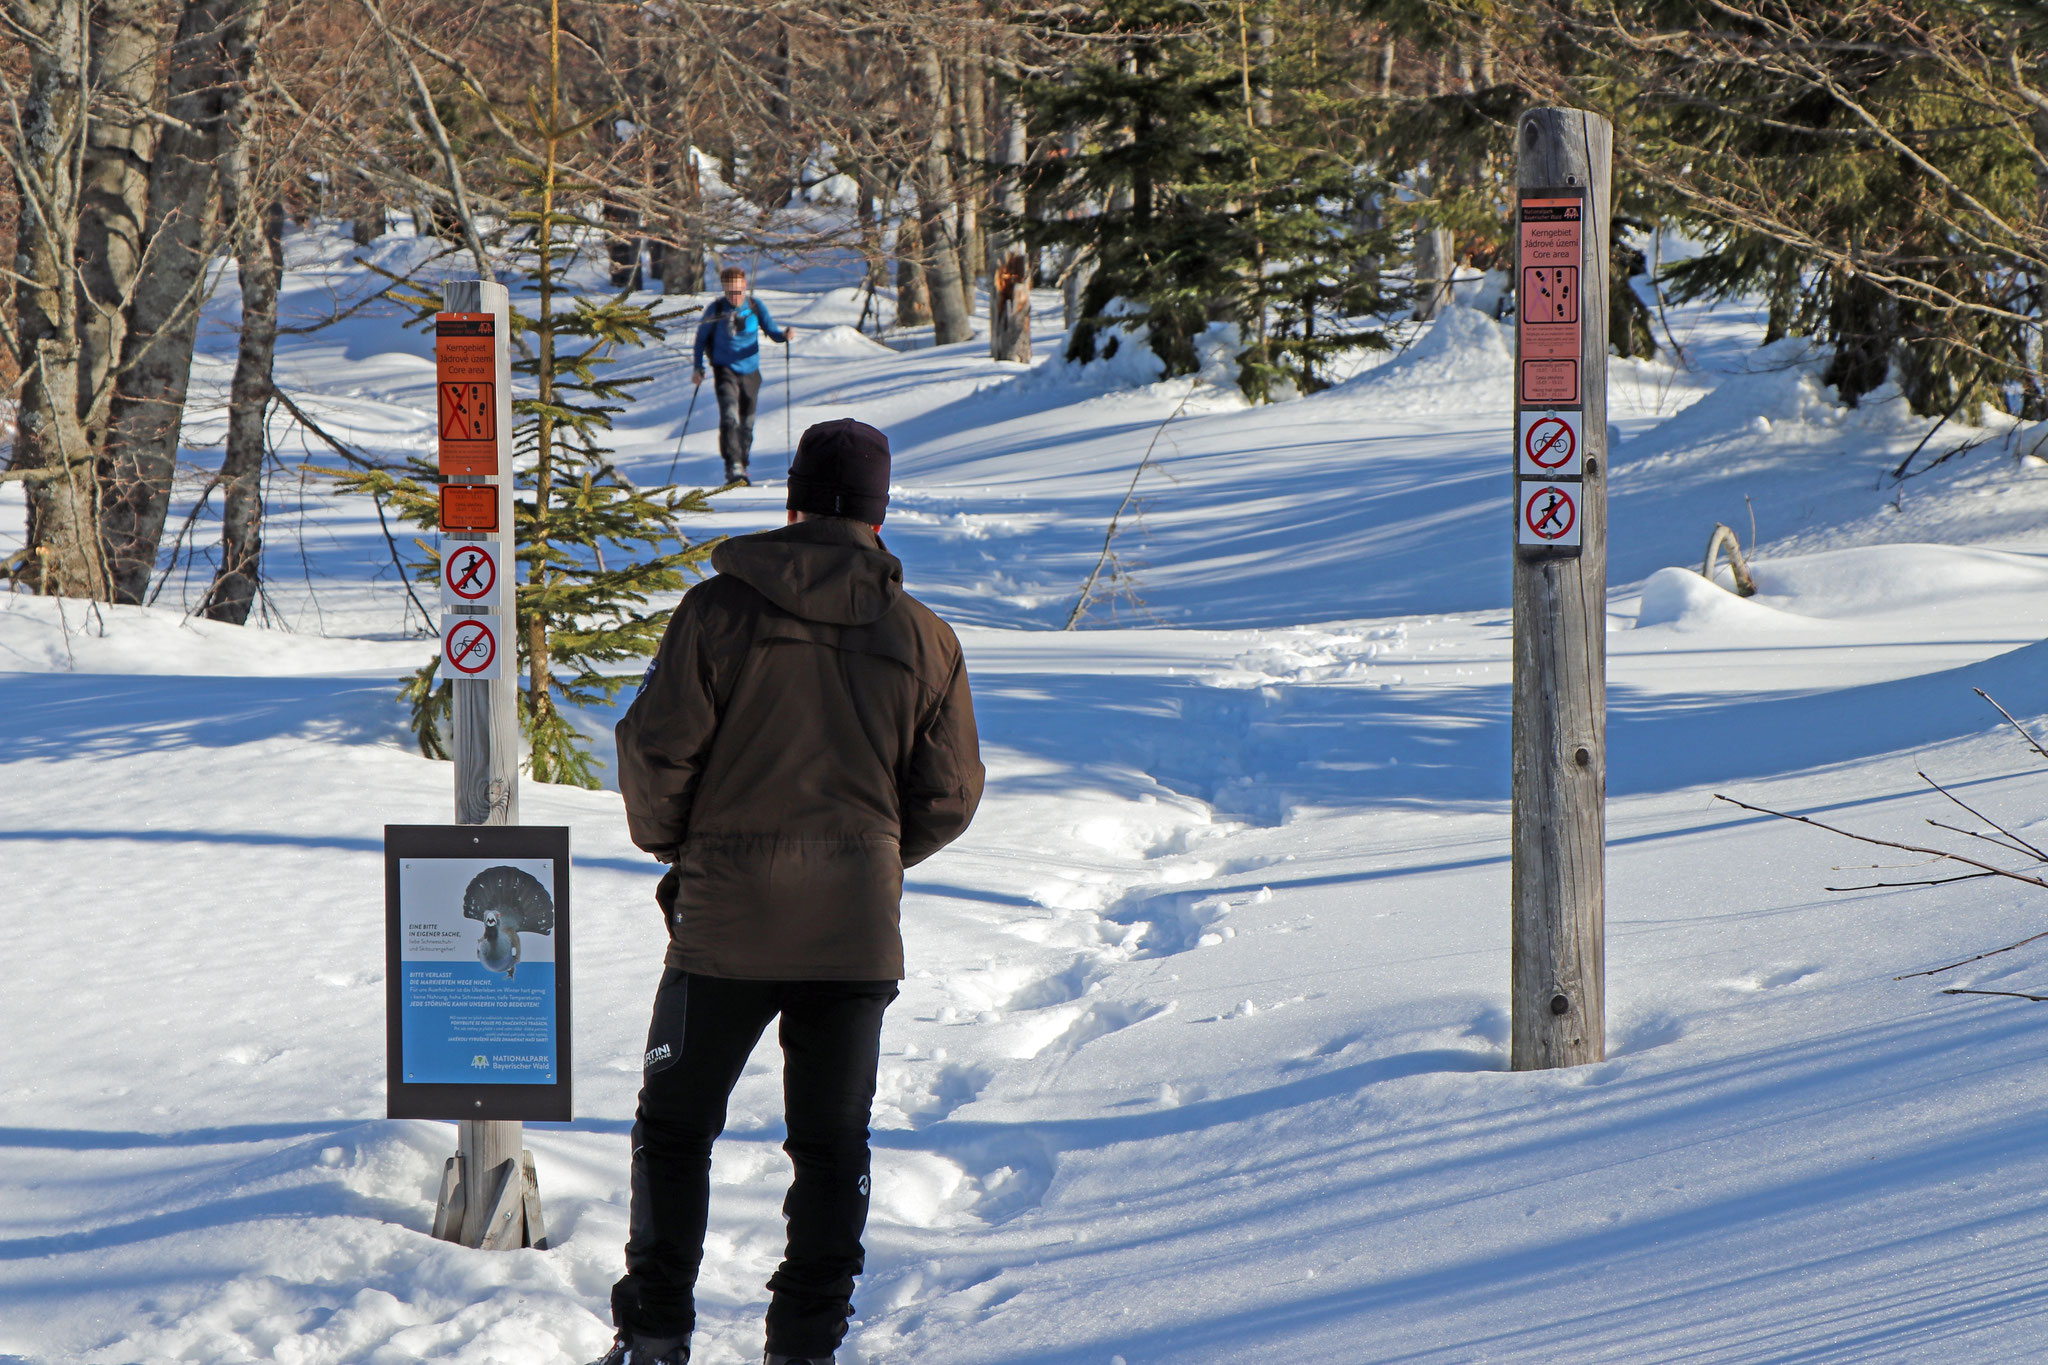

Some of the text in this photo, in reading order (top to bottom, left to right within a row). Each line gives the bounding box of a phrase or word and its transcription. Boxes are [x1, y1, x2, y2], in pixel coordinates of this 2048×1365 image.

[1531, 228, 1572, 238] Kerngebiet
[1524, 239, 1554, 248] Jádrové
[1533, 250, 1550, 258] Core
[446, 344, 486, 353] Kerngebiet
[644, 1044, 670, 1064] RTINI
[493, 1062, 531, 1071] Bayerischer
